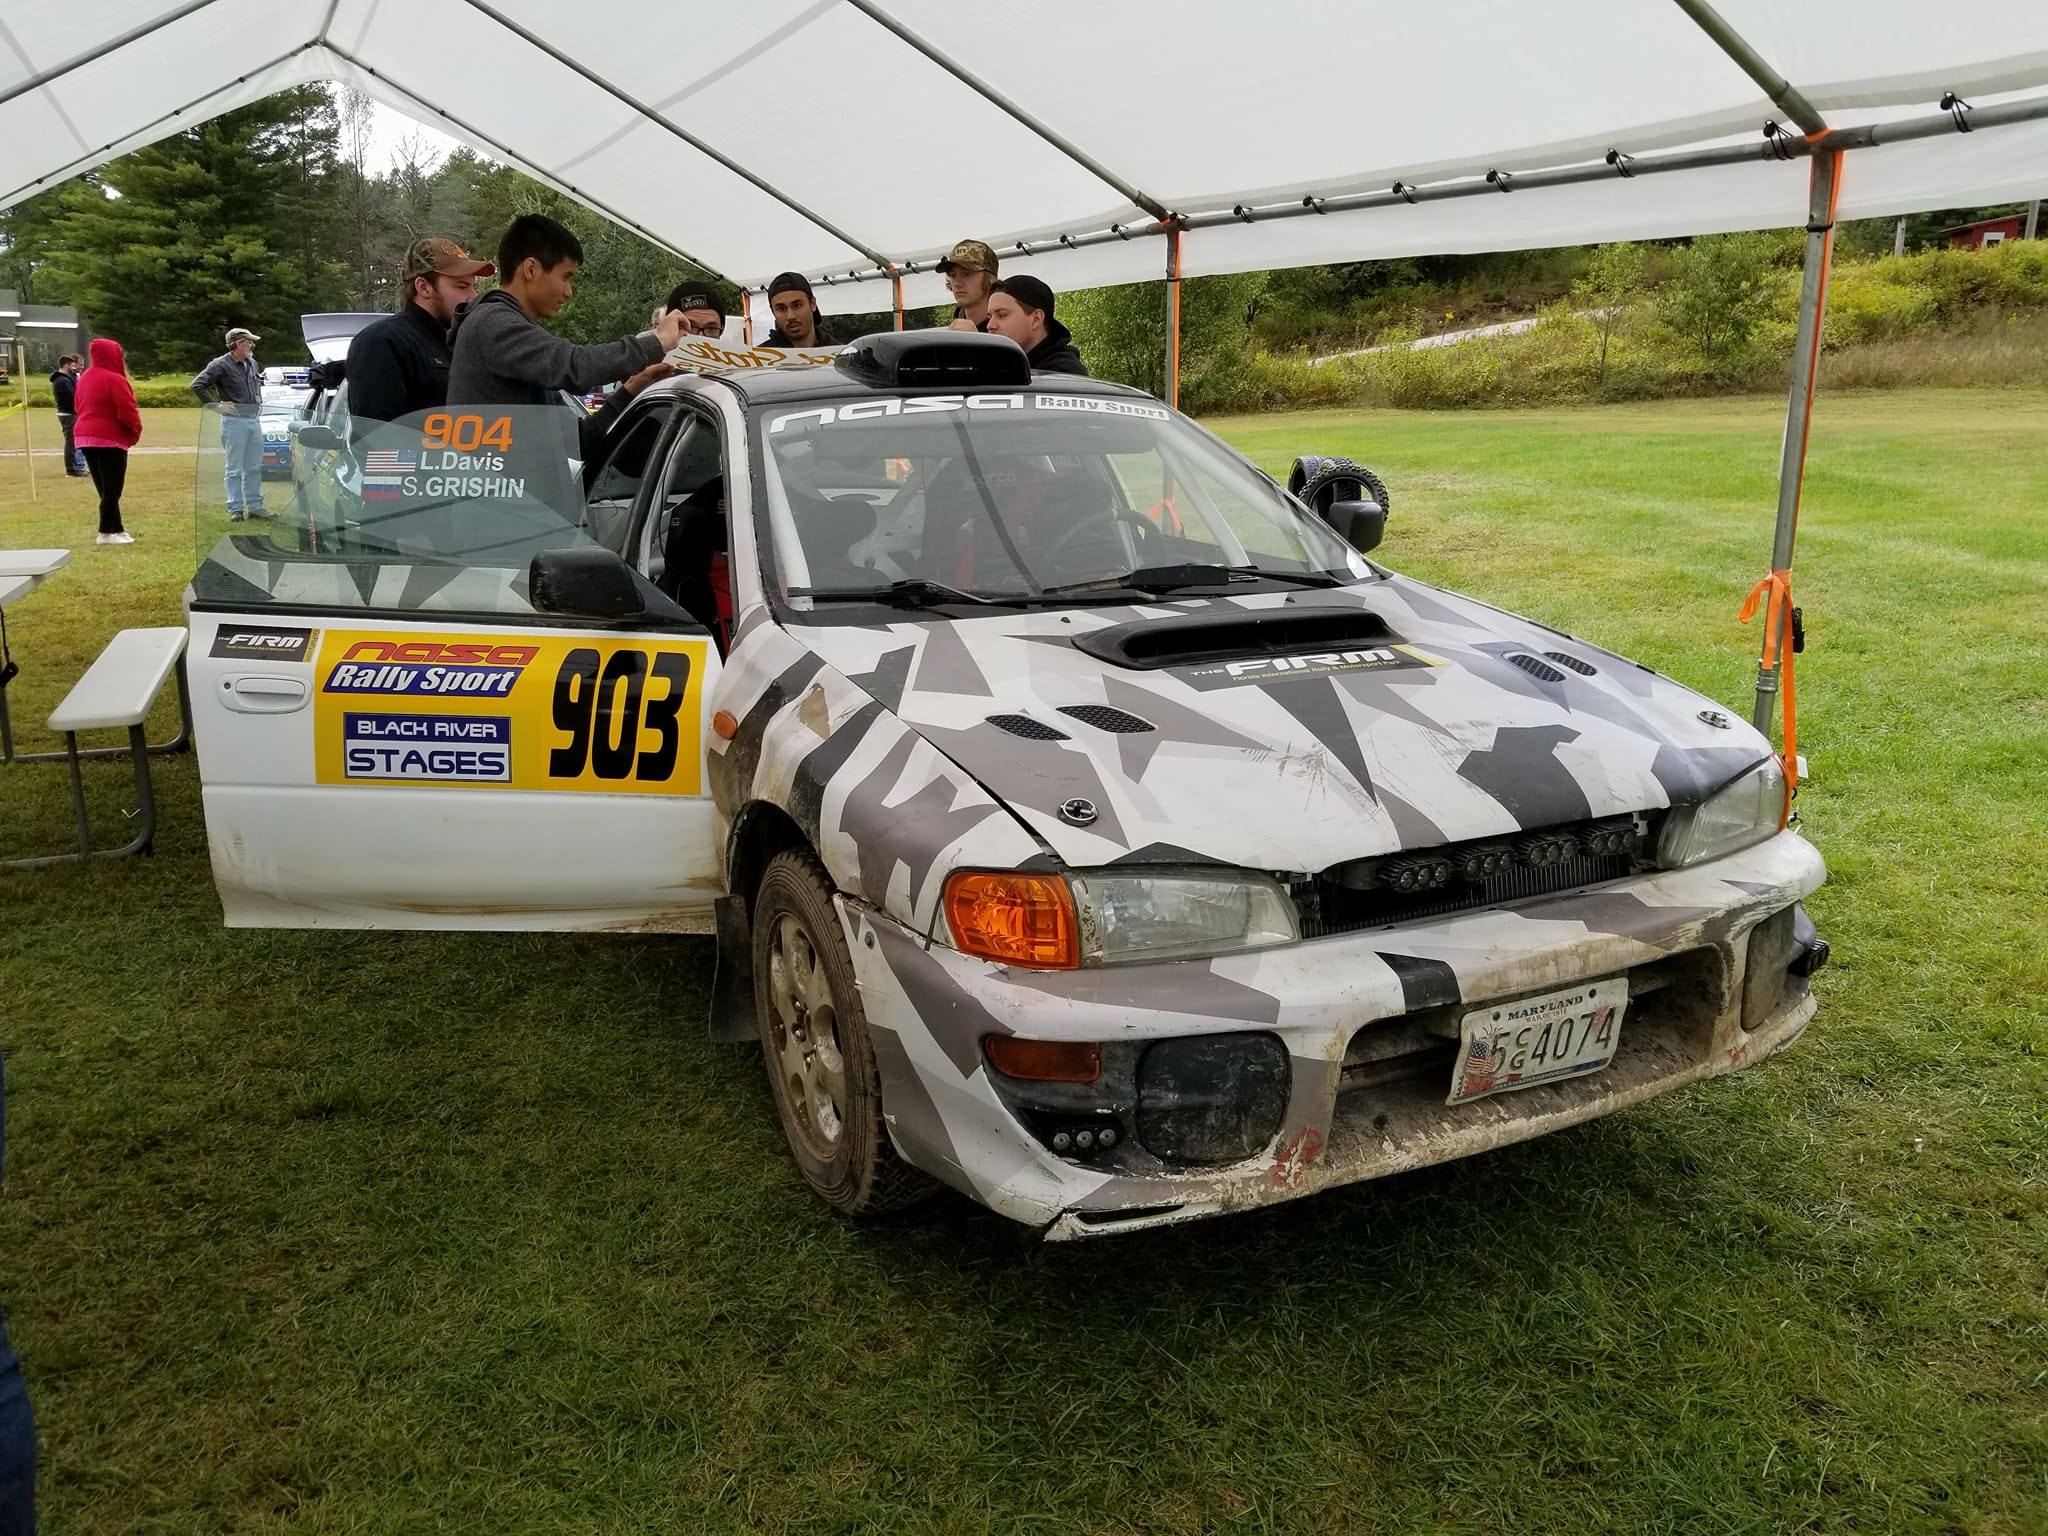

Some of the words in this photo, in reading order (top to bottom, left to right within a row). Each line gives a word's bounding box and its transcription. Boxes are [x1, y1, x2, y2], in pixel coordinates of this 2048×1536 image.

[1040, 397, 1099, 410] Rally
[1105, 402, 1166, 419] Sport
[422, 413, 513, 453] 904
[420, 451, 505, 471] L.Davis
[402, 476, 525, 498] S.GRISHIN
[229, 634, 304, 648] FIRM
[1189, 668, 1225, 676] THE
[1225, 649, 1396, 676] FIRM
[331, 664, 417, 691] Rally
[419, 667, 515, 693] Sport
[549, 648, 691, 782] 903
[357, 720, 428, 736] BLACK
[434, 722, 497, 738] RIVER
[349, 748, 505, 776] STAGES
[1507, 995, 1584, 1021] MARYLAND
